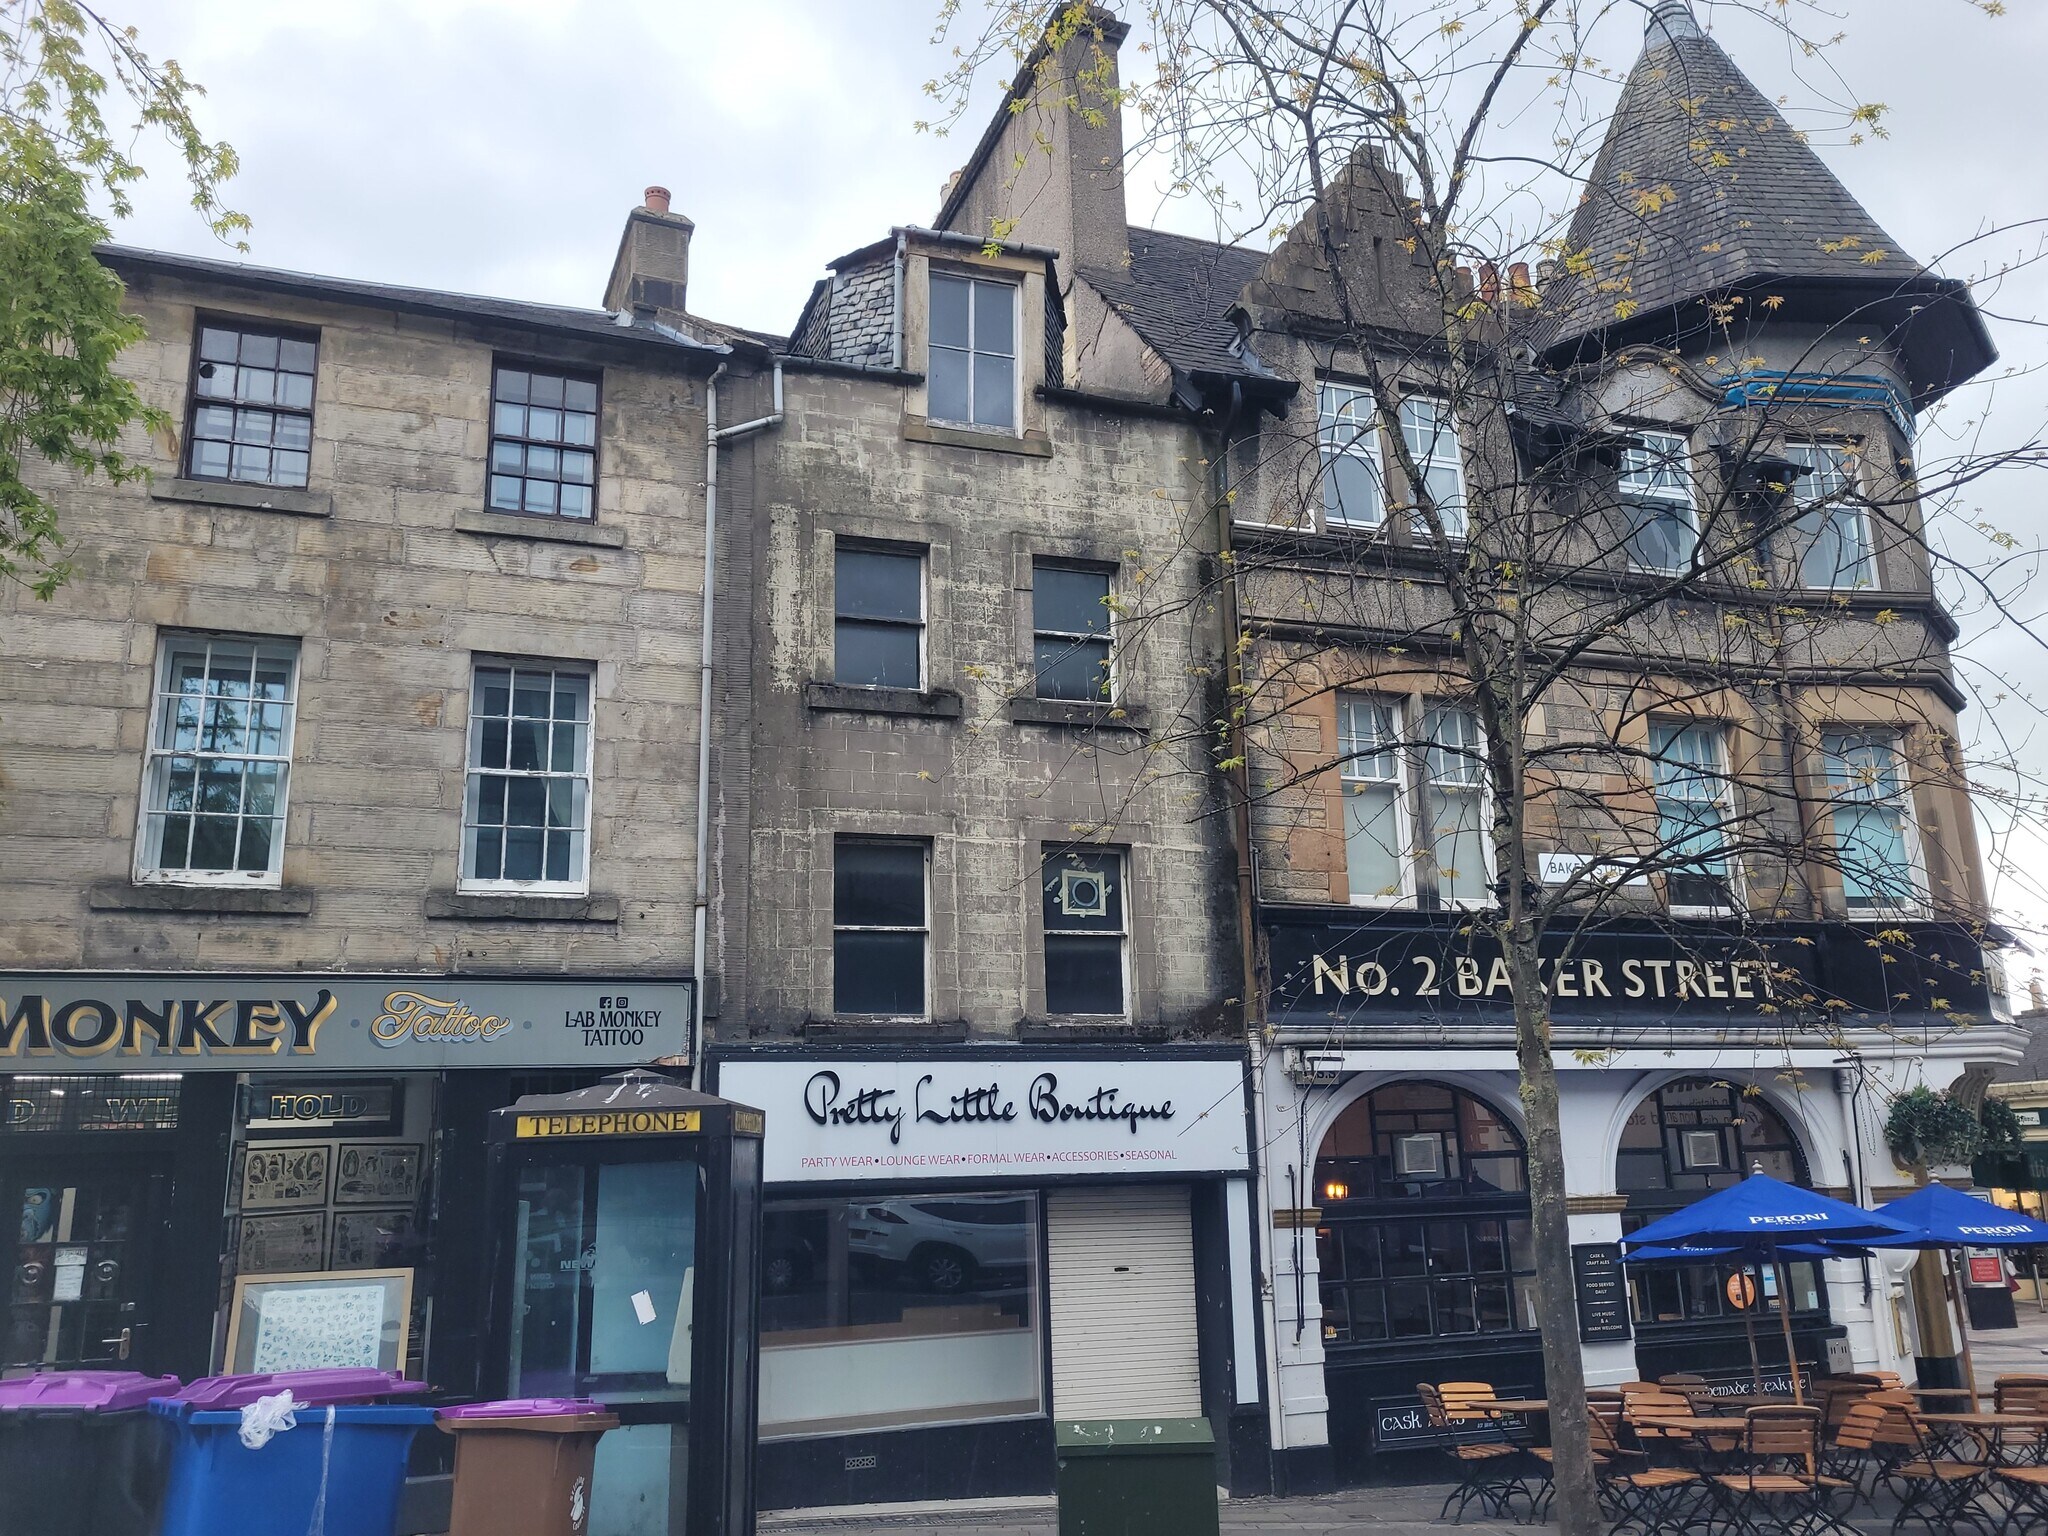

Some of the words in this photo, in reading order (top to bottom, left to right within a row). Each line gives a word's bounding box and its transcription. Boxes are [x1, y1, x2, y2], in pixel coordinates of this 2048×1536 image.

[1312, 954, 1399, 996] No.
[1412, 955, 1441, 996] 2
[1621, 959, 1779, 998] STREET
[0, 989, 337, 1058] MONKEY
[369, 989, 512, 1044] Tattoo
[565, 1011, 595, 1028] LAB
[599, 1011, 662, 1028] MONKEY
[580, 1029, 644, 1047] TATTOO
[269, 1094, 368, 1120] HOLD
[803, 1070, 907, 1145] Pretty
[915, 1074, 1019, 1125] Little
[1029, 1072, 1177, 1135] Boutique
[530, 1112, 689, 1135] TELEPHONE
[801, 1157, 838, 1168] PARTY
[839, 1156, 874, 1167] WEAR
[880, 1155, 927, 1166] LOUNGE
[928, 1154, 961, 1165] WEAR
[967, 1154, 1013, 1165] FORMAL
[1014, 1153, 1047, 1164] WEAR
[1051, 1151, 1120, 1162] ACCESSORIES
[1125, 1150, 1178, 1161] SEASONAL
[1748, 1212, 1829, 1224] PERONI
[1957, 1224, 2034, 1235] PERONI
[1788, 1377, 1806, 1394] pe
